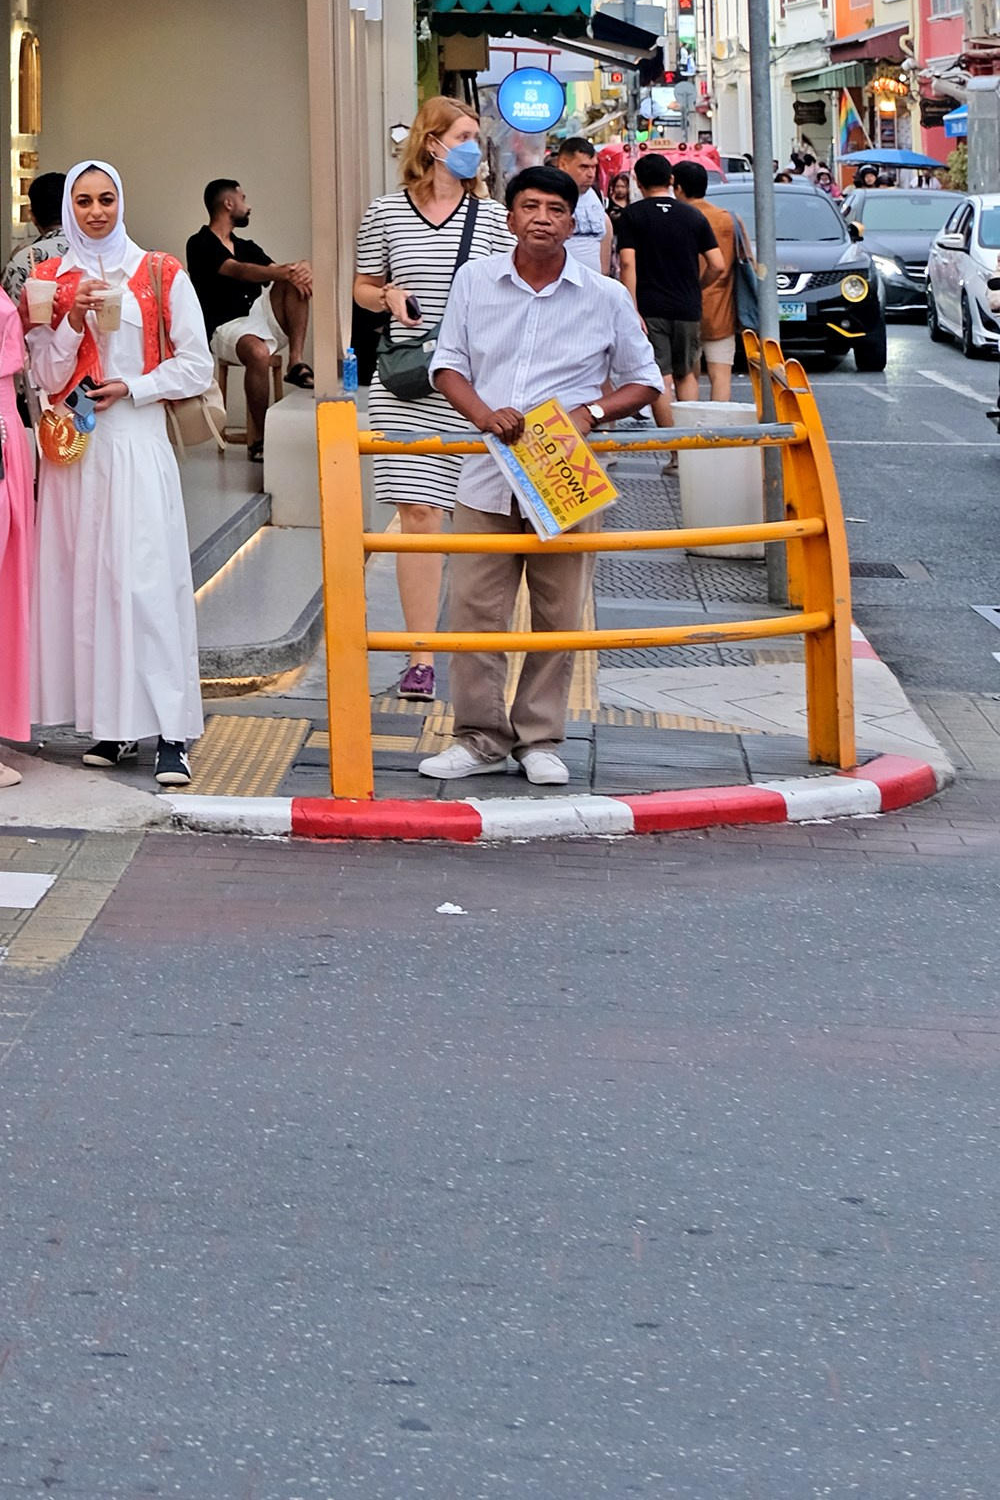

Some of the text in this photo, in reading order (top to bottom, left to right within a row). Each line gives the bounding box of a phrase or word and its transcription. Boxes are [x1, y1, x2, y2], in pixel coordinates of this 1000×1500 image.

[782, 303, 804, 313] 5577
[519, 429, 580, 513] SERVICE
[532, 423, 590, 505] OLD TOWN
[543, 403, 609, 499] TAXI
